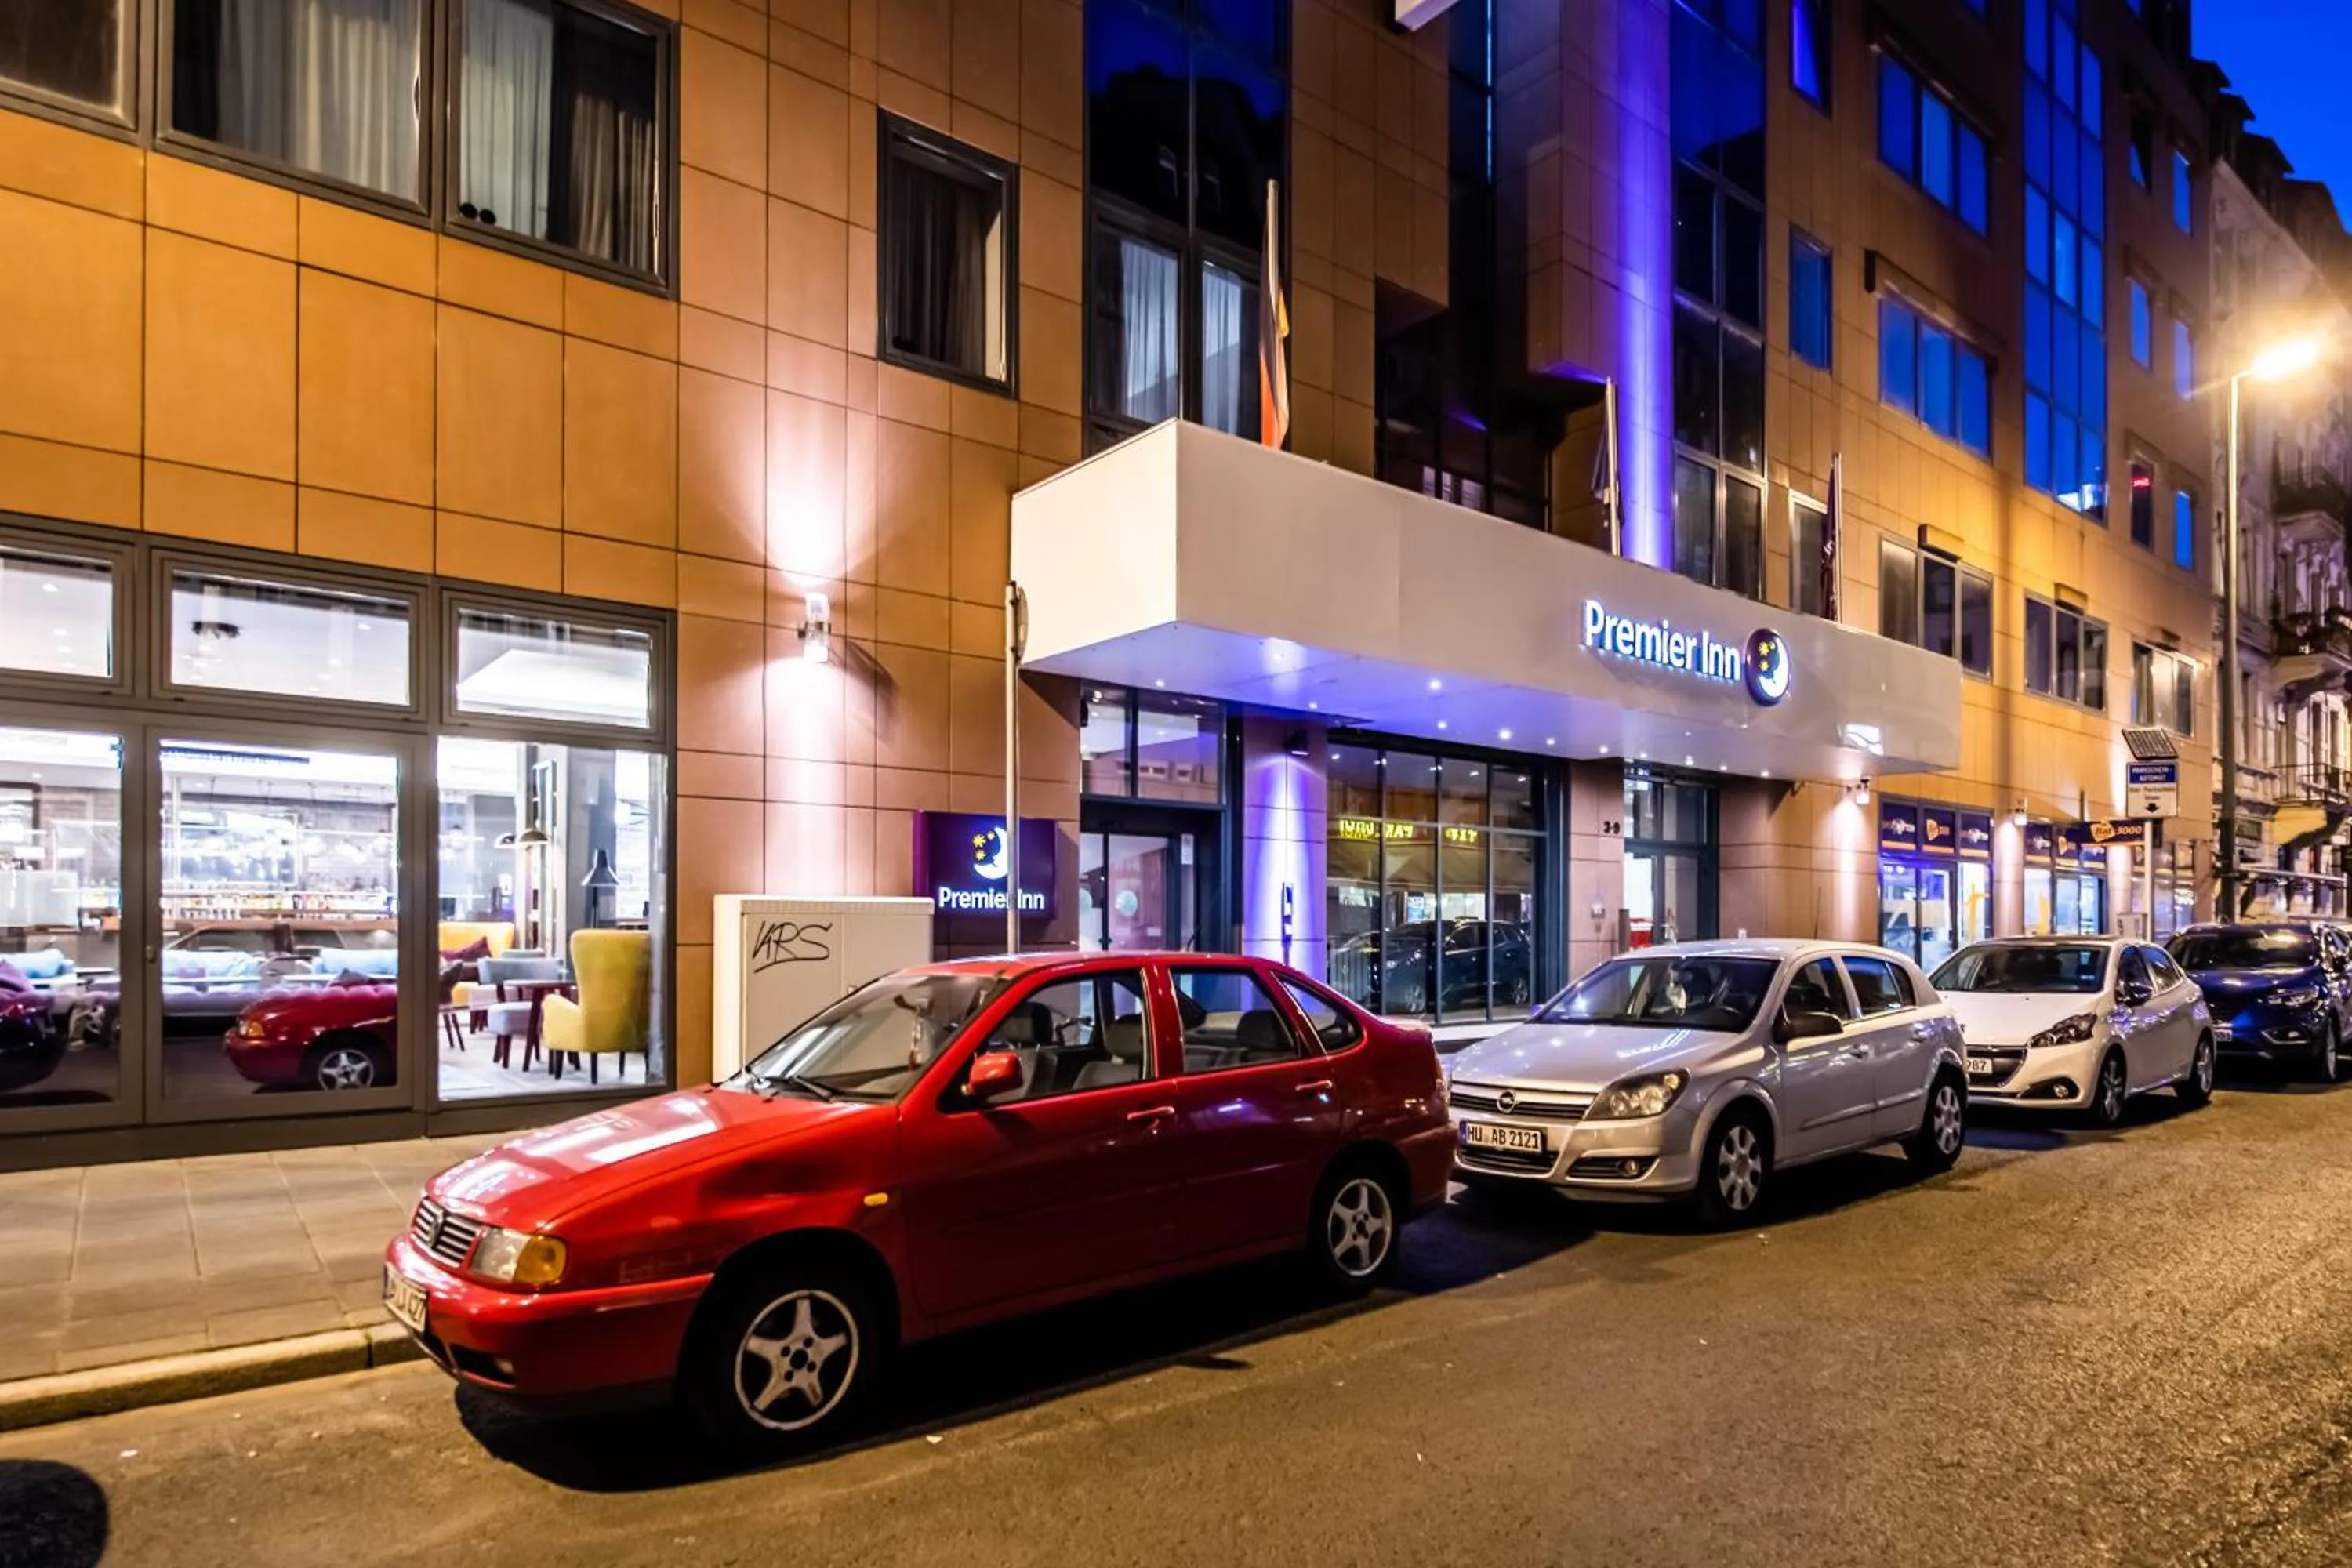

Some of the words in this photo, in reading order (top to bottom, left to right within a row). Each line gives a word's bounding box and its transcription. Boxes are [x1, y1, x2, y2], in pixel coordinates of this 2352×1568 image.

[1584, 600, 1697, 670] Premier
[1701, 630, 1741, 681] Inn
[2116, 825, 2142, 836] 3000
[1017, 888, 1044, 909] Inn
[1468, 1126, 1483, 1142] HU
[1491, 1128, 1506, 1145] AB
[1509, 1130, 1539, 1149] 2121
